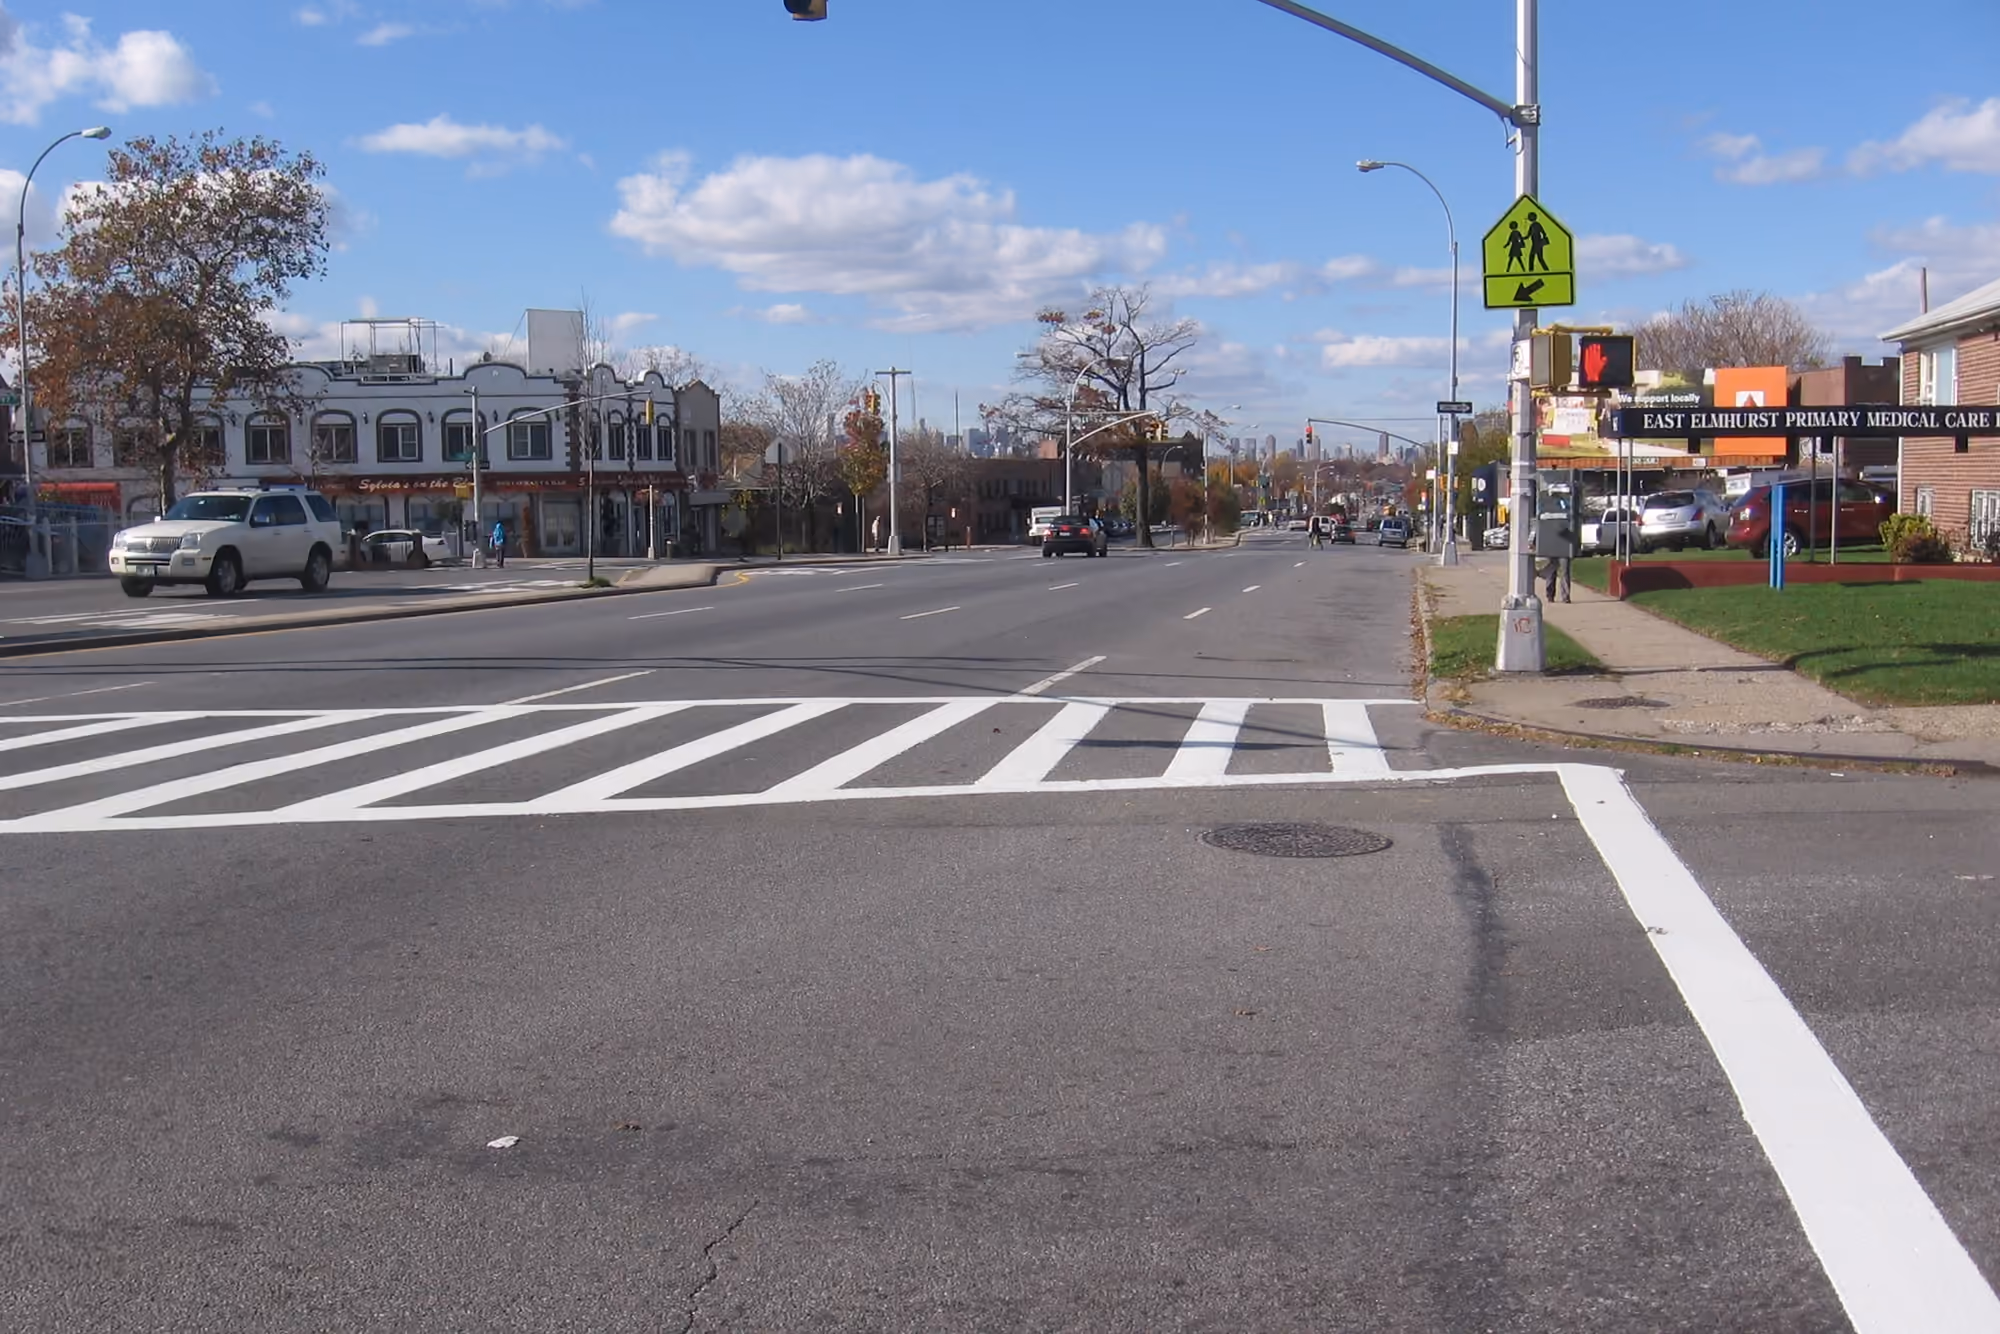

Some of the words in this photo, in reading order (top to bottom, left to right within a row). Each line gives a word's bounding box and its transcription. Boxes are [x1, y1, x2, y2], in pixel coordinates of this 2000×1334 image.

[1635, 394, 1669, 405] support
[1671, 392, 1701, 404] locally
[1643, 413, 1685, 429] EAST
[1690, 412, 1779, 429] ELMHURST
[1785, 411, 1861, 428] PRIMARY
[1866, 411, 1940, 428] MEDICAL
[1944, 412, 1990, 428] CARE
